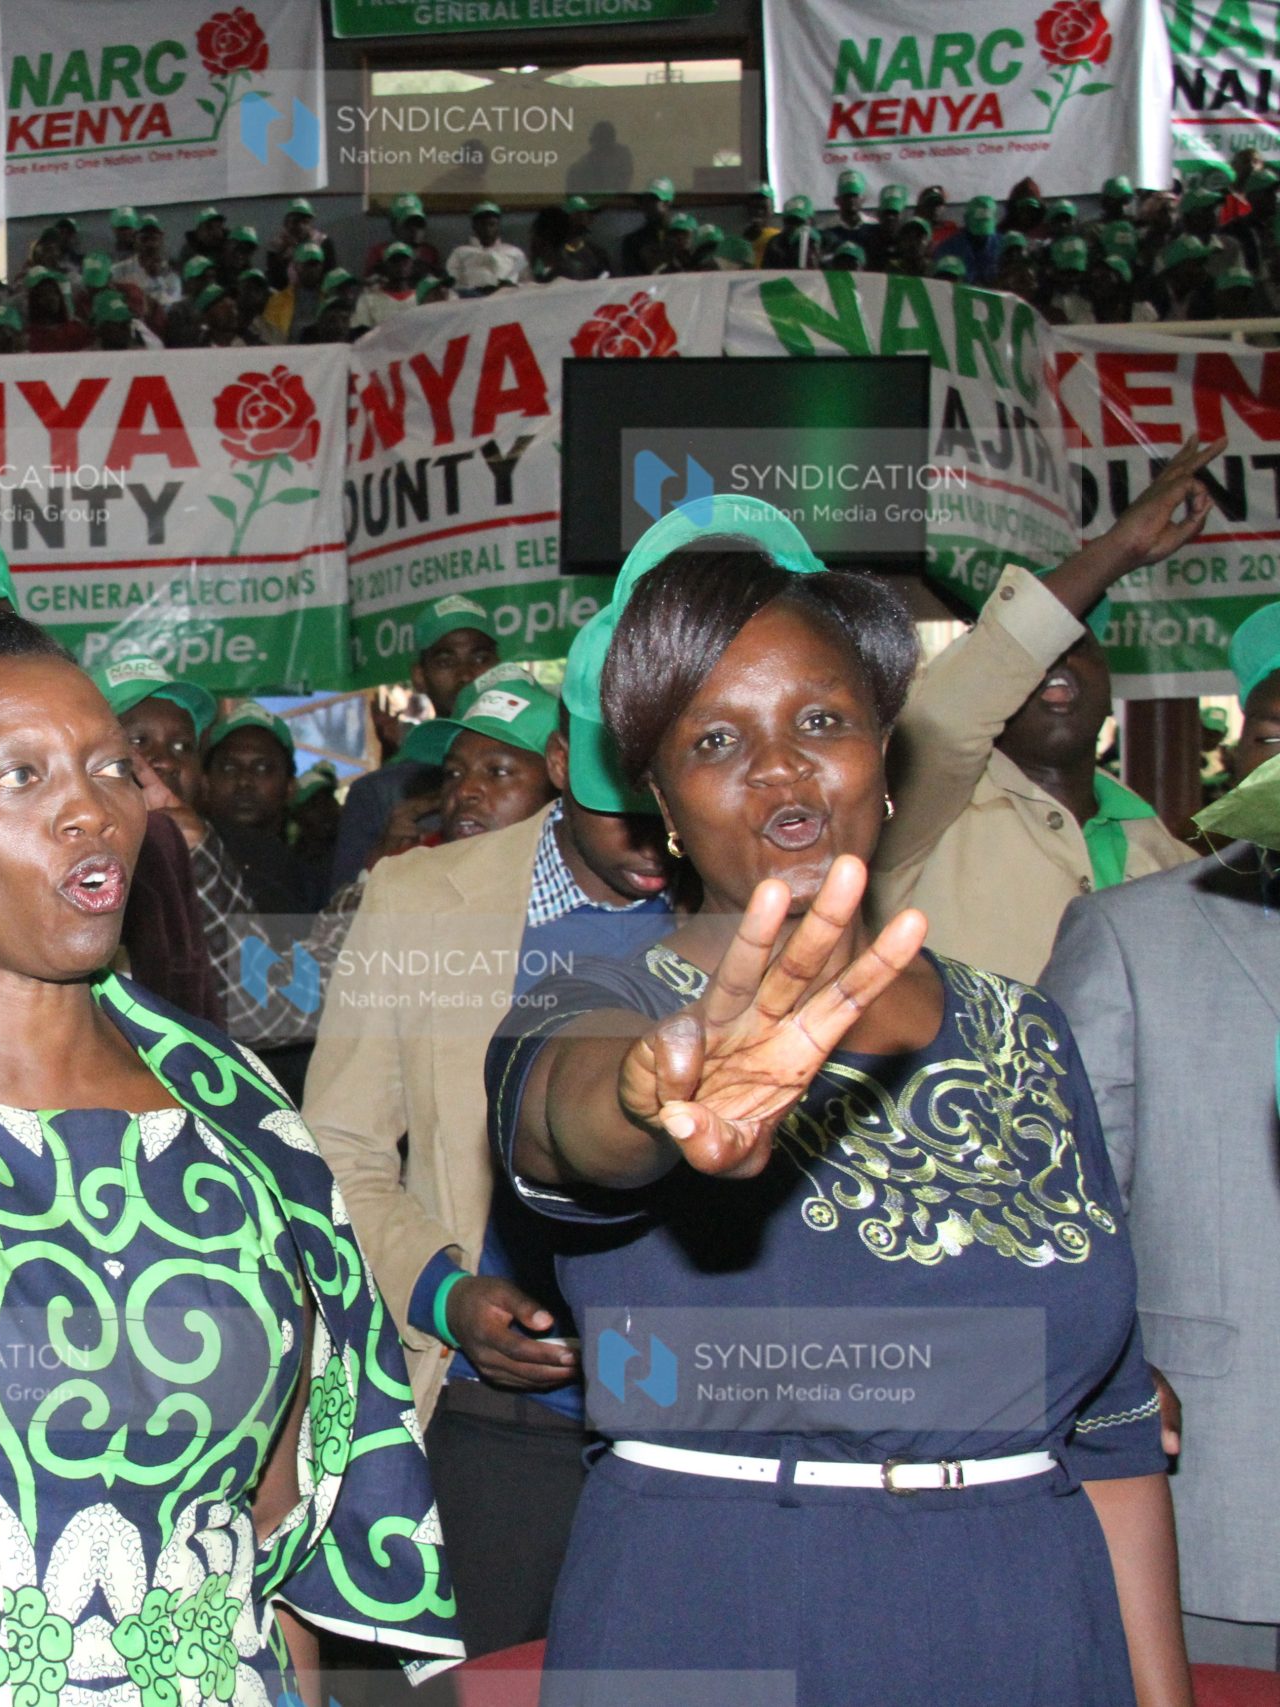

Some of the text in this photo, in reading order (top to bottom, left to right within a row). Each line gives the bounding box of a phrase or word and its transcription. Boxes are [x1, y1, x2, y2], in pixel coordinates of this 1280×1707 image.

[414, 3, 520, 25] GENERAL
[8, 39, 187, 109] NARC
[833, 28, 1025, 95] NARC
[5, 102, 173, 152] KENYA
[826, 92, 1004, 140] KENYA
[29, 582, 159, 614] GENERAL
[169, 569, 317, 610] ELECTIONS
[409, 545, 505, 590] GENERAL
[1166, 554, 1228, 586] FOR
[83, 626, 269, 676] People.
